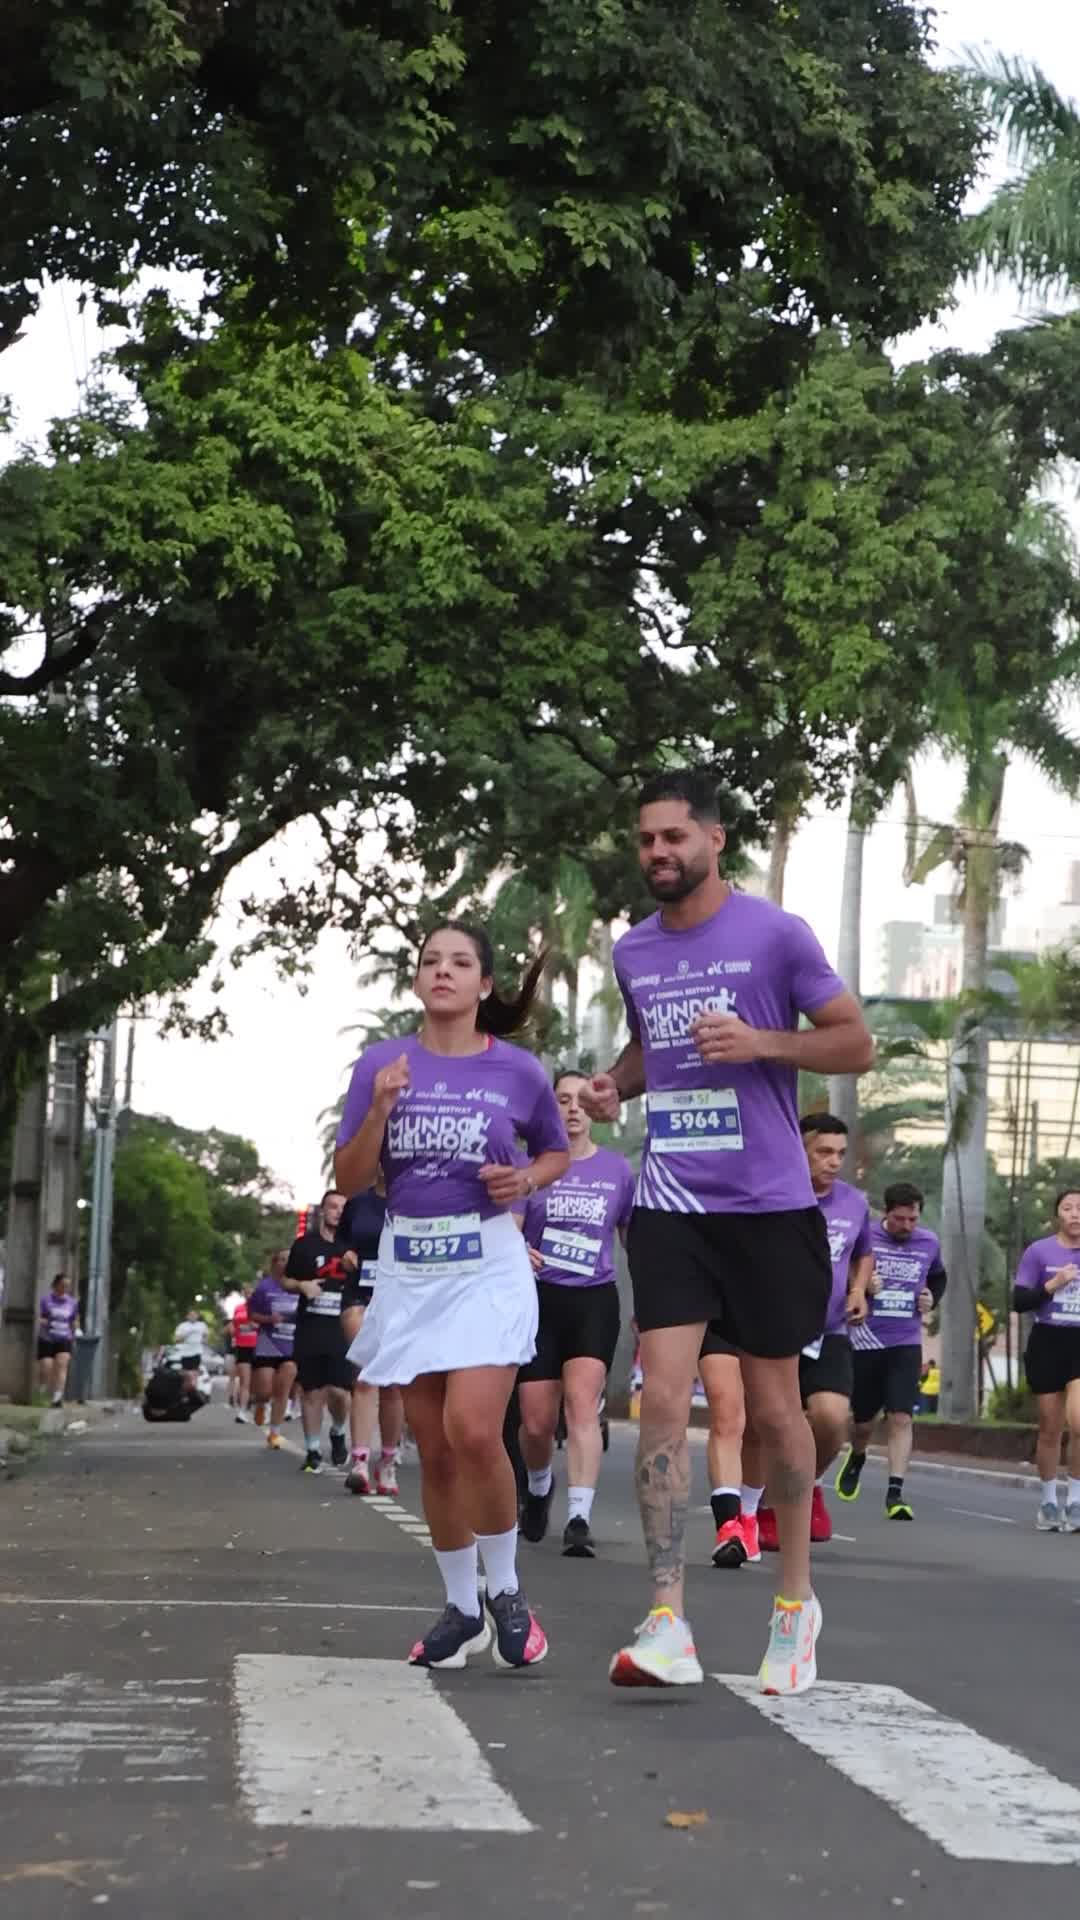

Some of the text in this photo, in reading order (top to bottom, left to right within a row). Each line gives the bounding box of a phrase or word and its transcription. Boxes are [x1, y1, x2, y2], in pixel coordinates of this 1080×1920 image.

[641, 997, 721, 1022] MUNDO
[647, 1016, 694, 1041] MELH
[388, 1115, 472, 1135] MUNDO
[670, 1111, 720, 1130] 5964
[389, 1131, 473, 1152] MELHOR
[546, 1195, 601, 1209] MUNDO
[547, 1205, 602, 1219] MELHOR
[409, 1236, 461, 1256] 5957
[552, 1243, 586, 1260] 6515
